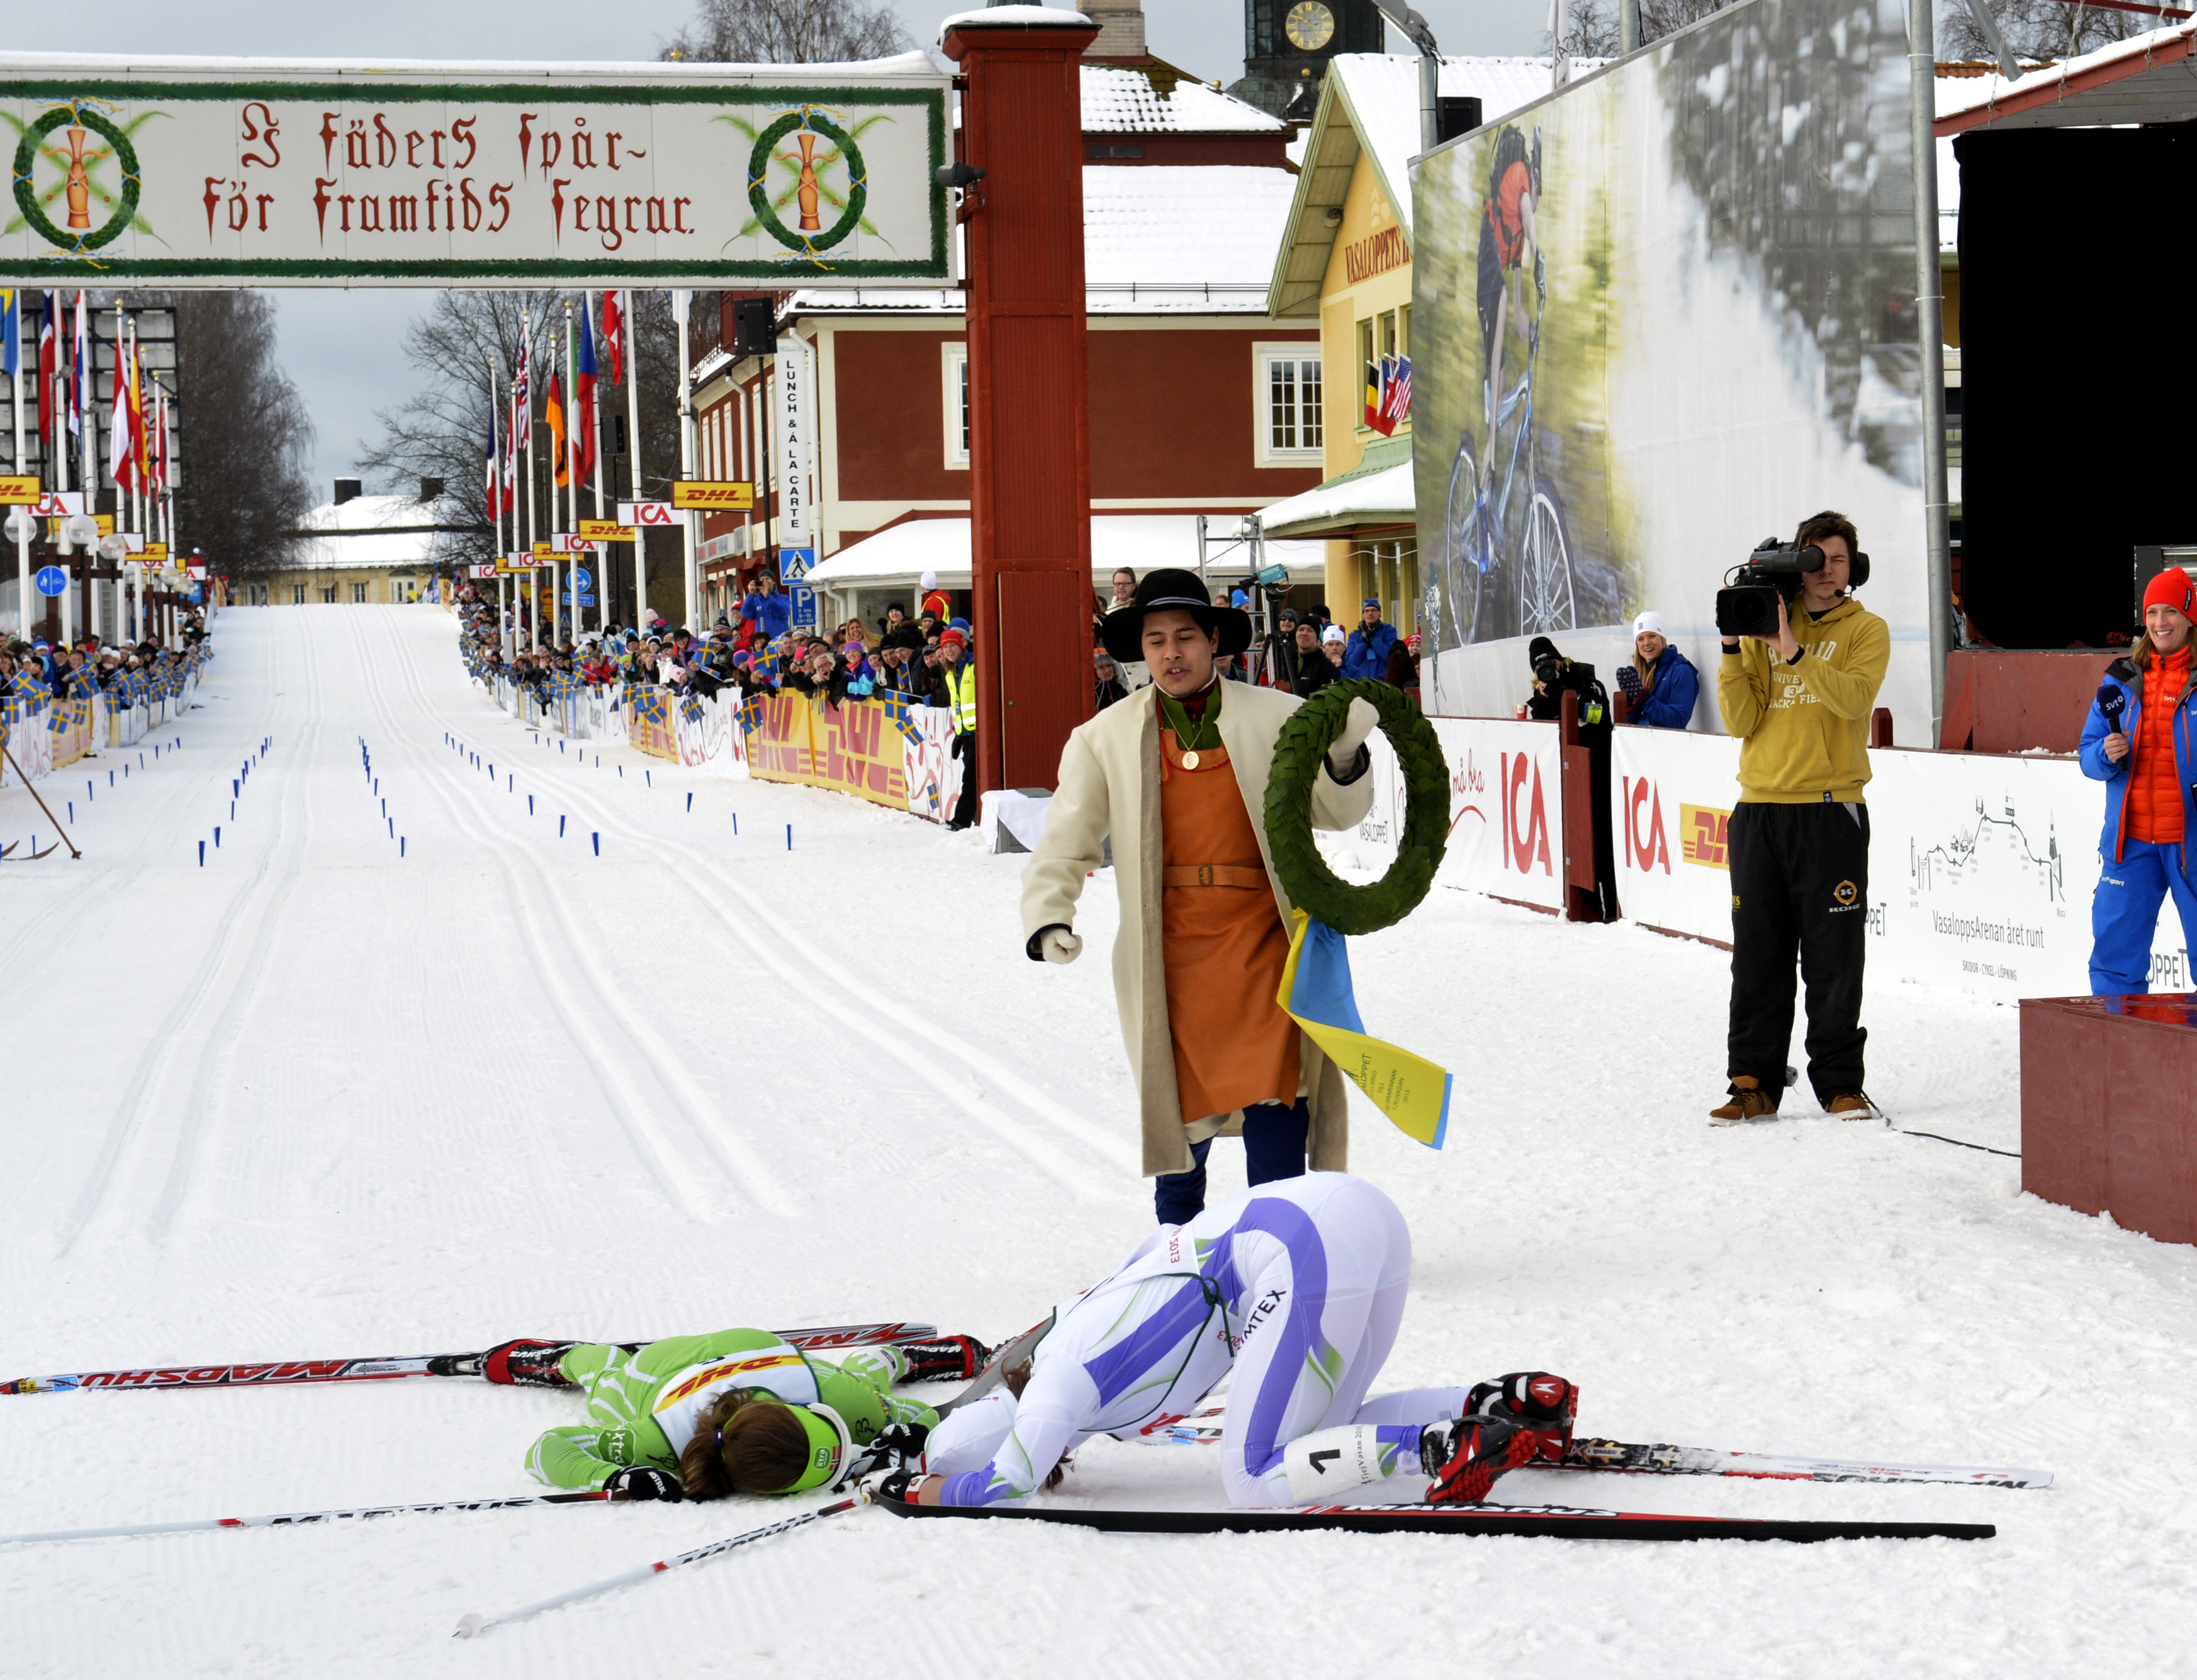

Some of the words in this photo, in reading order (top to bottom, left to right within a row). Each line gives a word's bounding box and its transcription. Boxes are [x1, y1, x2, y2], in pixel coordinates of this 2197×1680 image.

[1345, 225, 1400, 284] VASALOPPETS
[786, 360, 797, 413] LUNCH
[788, 419, 797, 428] &
[789, 450, 798, 469] LA
[0, 484, 27, 496] HL
[685, 490, 741, 501] DHL
[789, 476, 799, 528] CARTE
[633, 504, 672, 524] ICA
[589, 525, 632, 535] DHL
[564, 535, 595, 551] ICA
[797, 588, 812, 608] P
[2105, 697, 2120, 711] svt
[1500, 751, 1553, 877] ICA
[1359, 820, 1388, 844] VASALOPPET
[1622, 775, 1671, 875] ICA
[1694, 810, 1729, 866] DH
[1840, 888, 1853, 896] K
[2109, 878, 2125, 887] sport
[1829, 904, 1860, 913] KOHO
[1933, 910, 2005, 943] VasaloppsArenan
[2007, 918, 2025, 946] året
[2026, 926, 2045, 949] runt
[1962, 960, 1979, 974] SKIDOR
[1982, 964, 1995, 977] CYKEL
[1998, 964, 2018, 982] LÖPNING
[1377, 1081, 1385, 1094] TILL
[1392, 1077, 1405, 1111] TJEJVASAN
[1402, 1089, 1411, 1104] 2013
[1238, 1289, 1287, 1351] IMTEX
[666, 1356, 783, 1399] DHL
[1309, 1448, 1341, 1476] 1
[1357, 1441, 1370, 1482] TjejVasan
